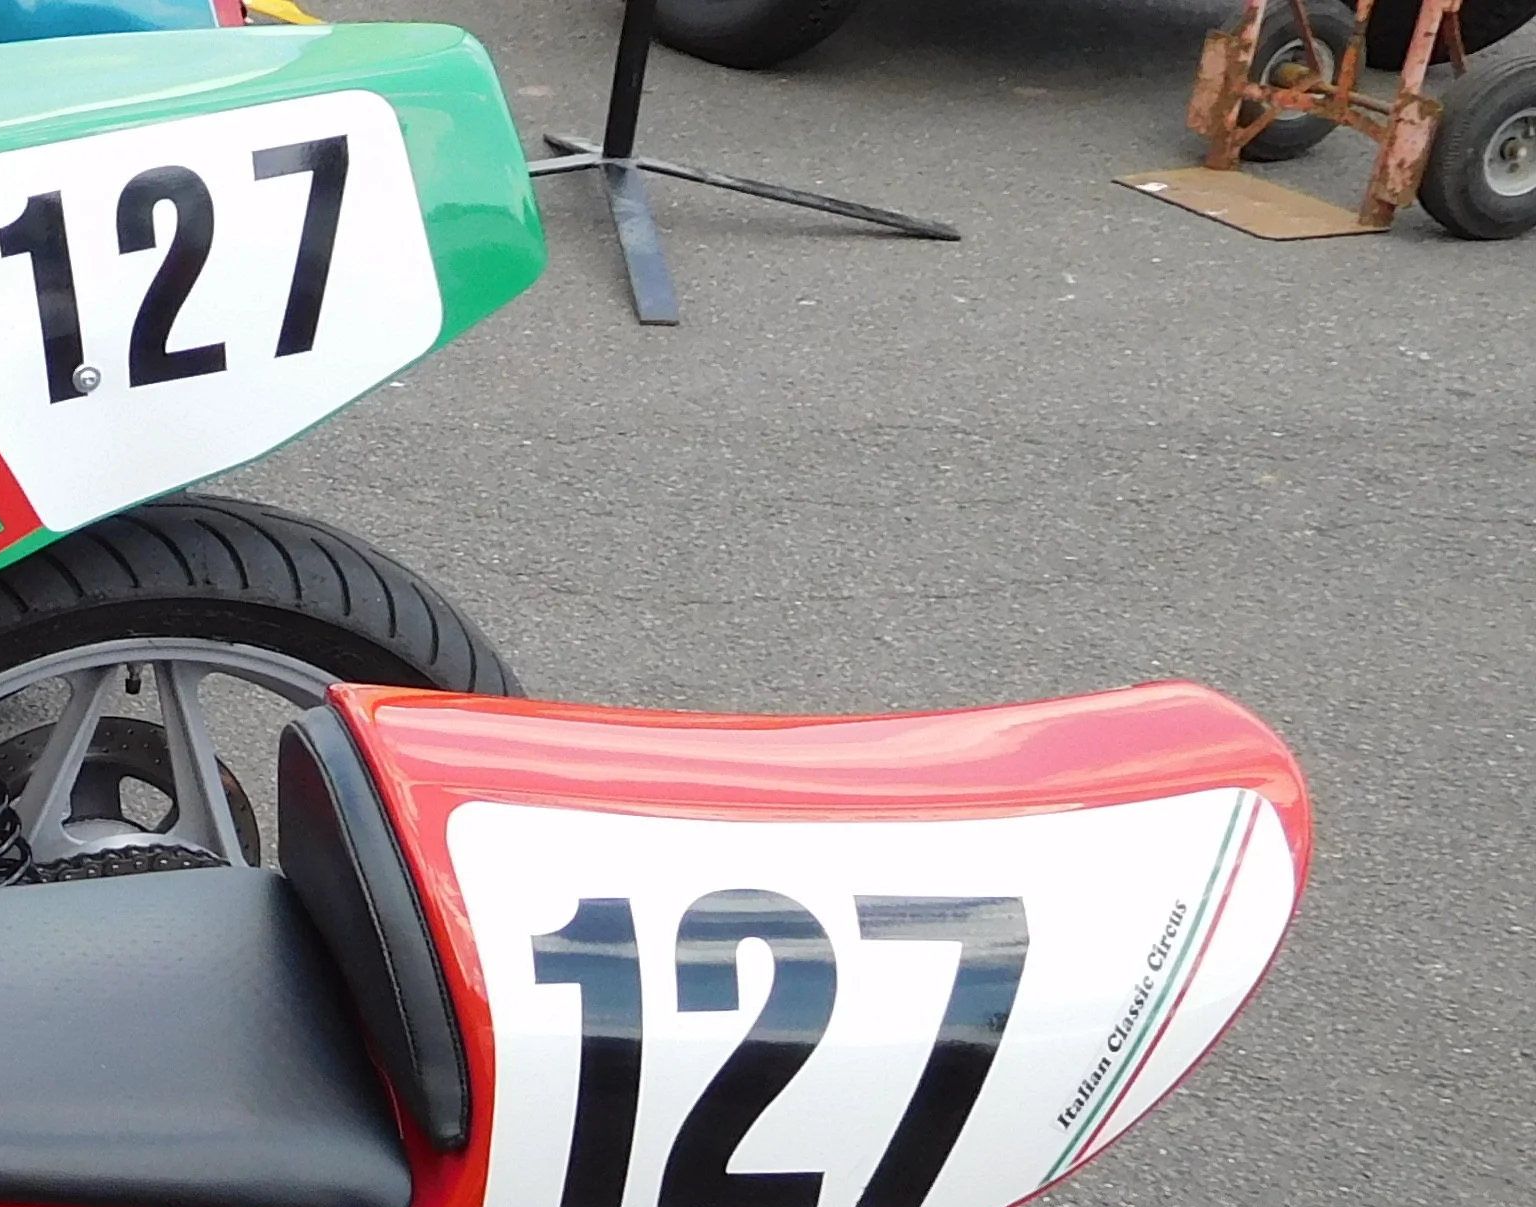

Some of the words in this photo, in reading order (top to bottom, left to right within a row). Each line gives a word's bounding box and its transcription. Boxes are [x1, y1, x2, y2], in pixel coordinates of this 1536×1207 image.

[1056, 1056, 1112, 1130] Italian
[1107, 975, 1154, 1053] Classic
[1147, 899, 1188, 972] Circus
